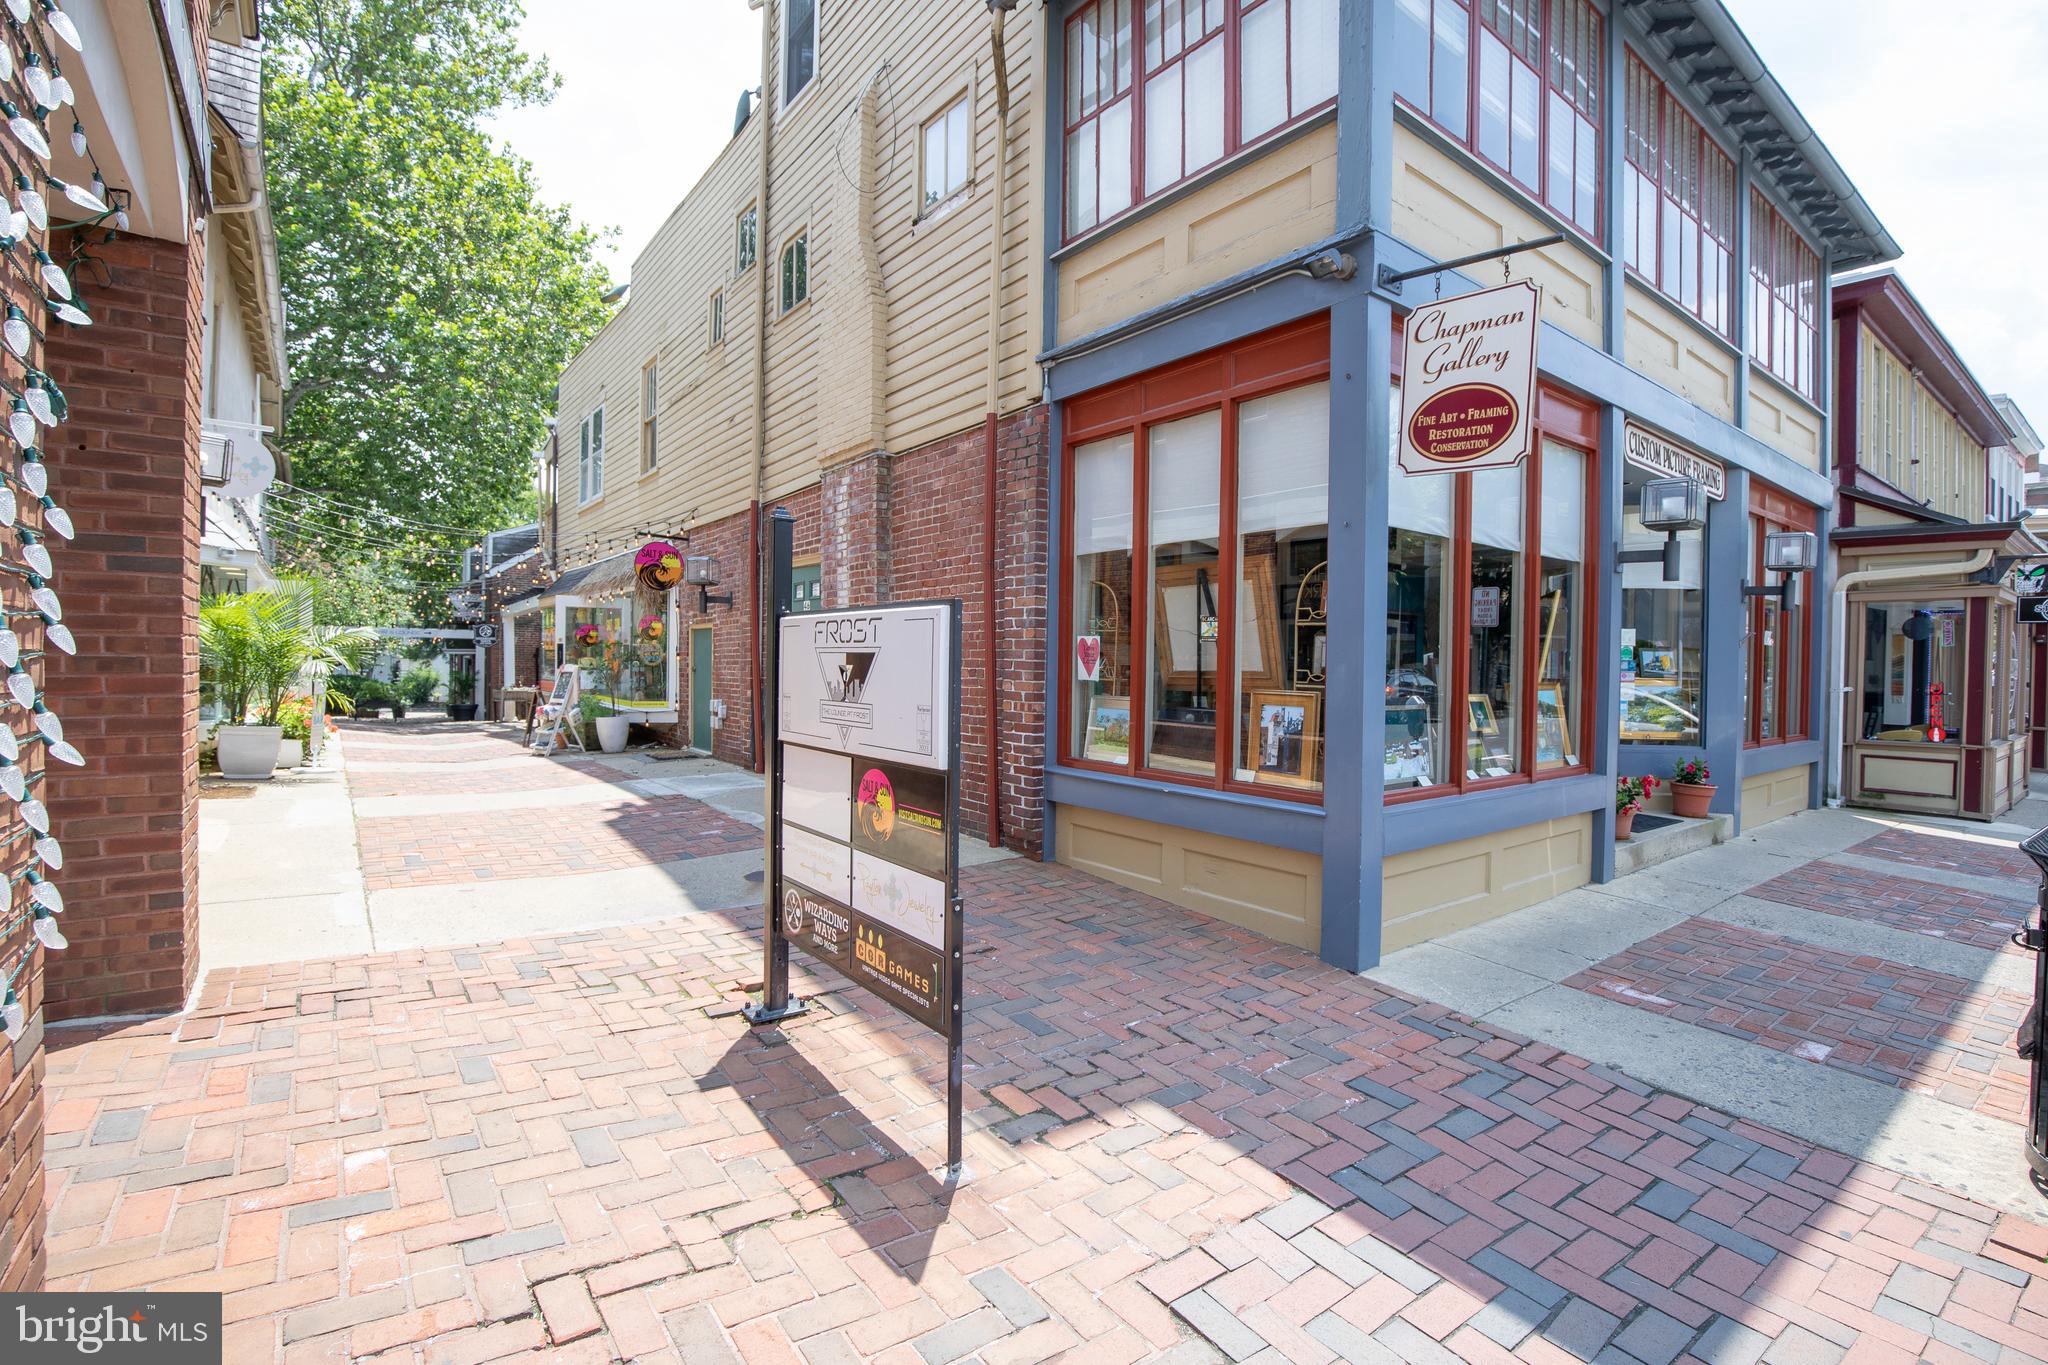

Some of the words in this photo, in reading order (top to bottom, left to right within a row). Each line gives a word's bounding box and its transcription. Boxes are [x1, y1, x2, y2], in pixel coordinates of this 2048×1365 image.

[1414, 309, 1525, 344] Chapman
[1422, 335, 1510, 385] Gallery
[1417, 414, 1436, 427] FINE
[1439, 411, 1458, 424] ART
[1467, 405, 1509, 421] FRAMING
[1428, 423, 1494, 441] RESTORATION
[1430, 437, 1490, 454] CONSERVATION
[1628, 431, 1661, 466] CUSTOM
[1662, 446, 1691, 476] PICTURE
[1692, 460, 1720, 491] FRAMING
[814, 617, 883, 644] FROST
[854, 711, 869, 720] FROST
[1930, 683, 1943, 729] OPEN
[862, 778, 874, 793] SALT
[803, 898, 849, 932] WIZARDING
[812, 933, 824, 946] AND
[823, 939, 839, 955] MORE
[813, 918, 837, 943] WAYS
[861, 963, 878, 978] VINTAGE
[877, 973, 891, 986] VIDEO
[890, 980, 902, 993] GAME
[902, 987, 930, 1008] SPECIALISTS
[889, 960, 929, 993] GAMES
